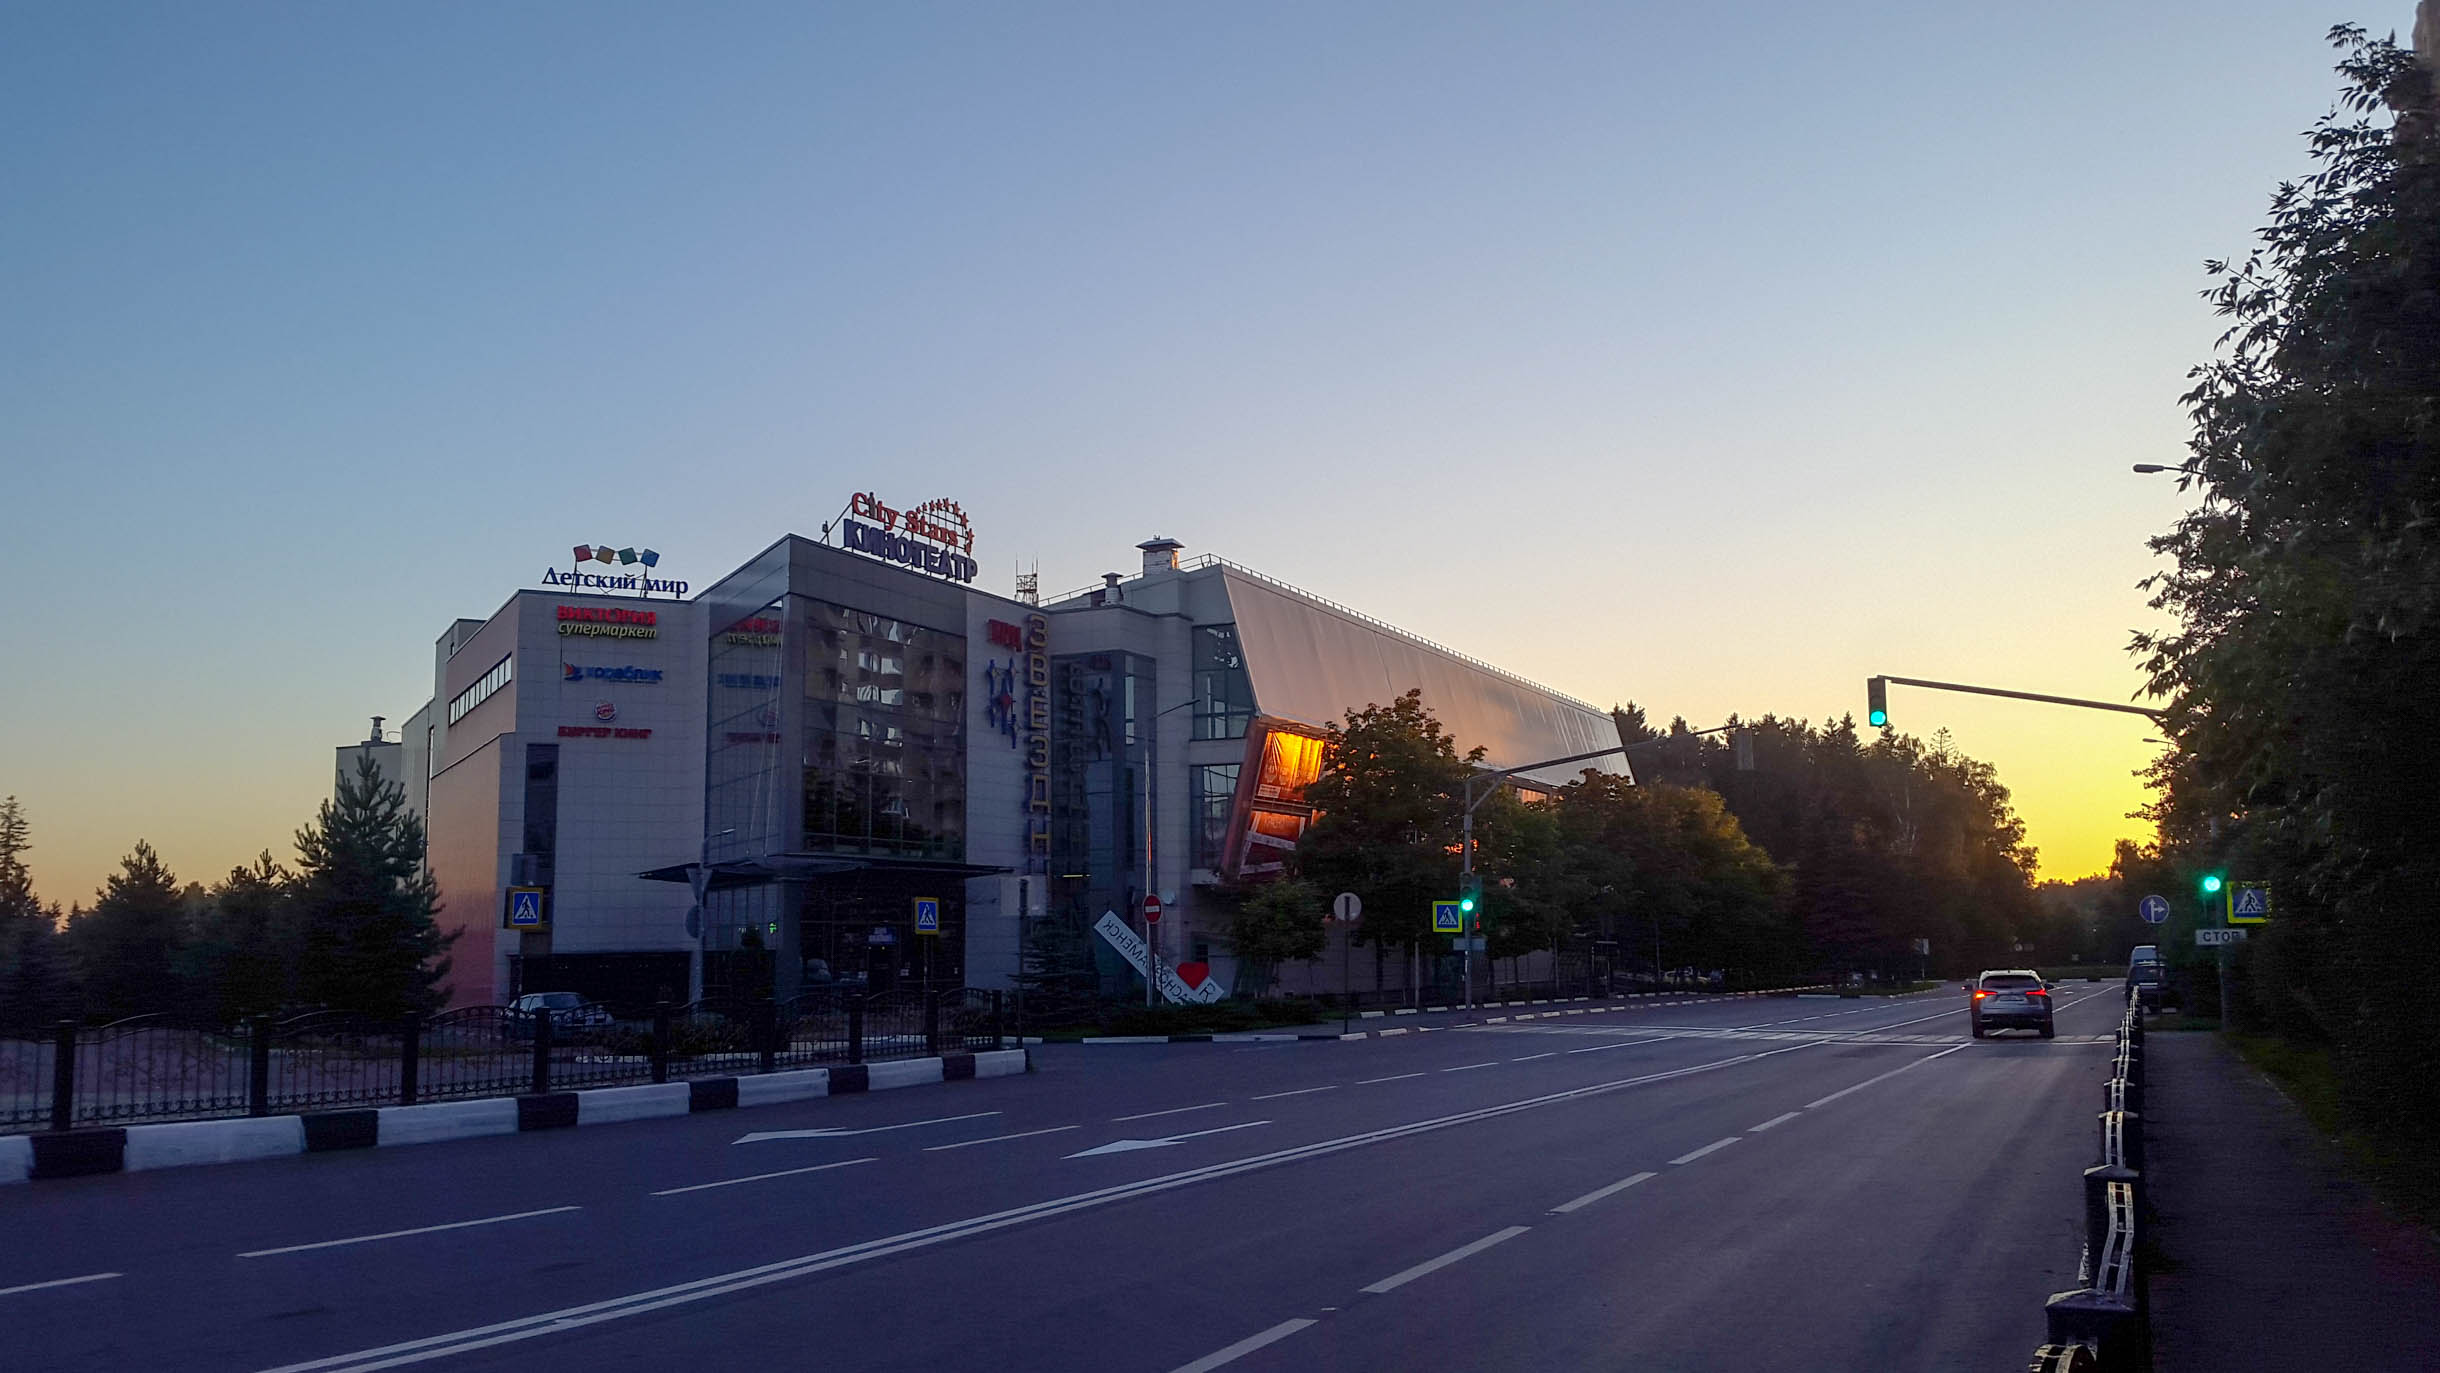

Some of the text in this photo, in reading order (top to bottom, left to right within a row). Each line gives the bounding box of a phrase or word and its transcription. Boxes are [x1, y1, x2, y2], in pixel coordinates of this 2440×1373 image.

[851, 492, 958, 547] City Stars
[843, 518, 978, 583] КИНОТЕАТР
[542, 566, 689, 599] Детский мир
[557, 605, 657, 627] ВИКТОРИЯ
[558, 621, 657, 640] супермаркет
